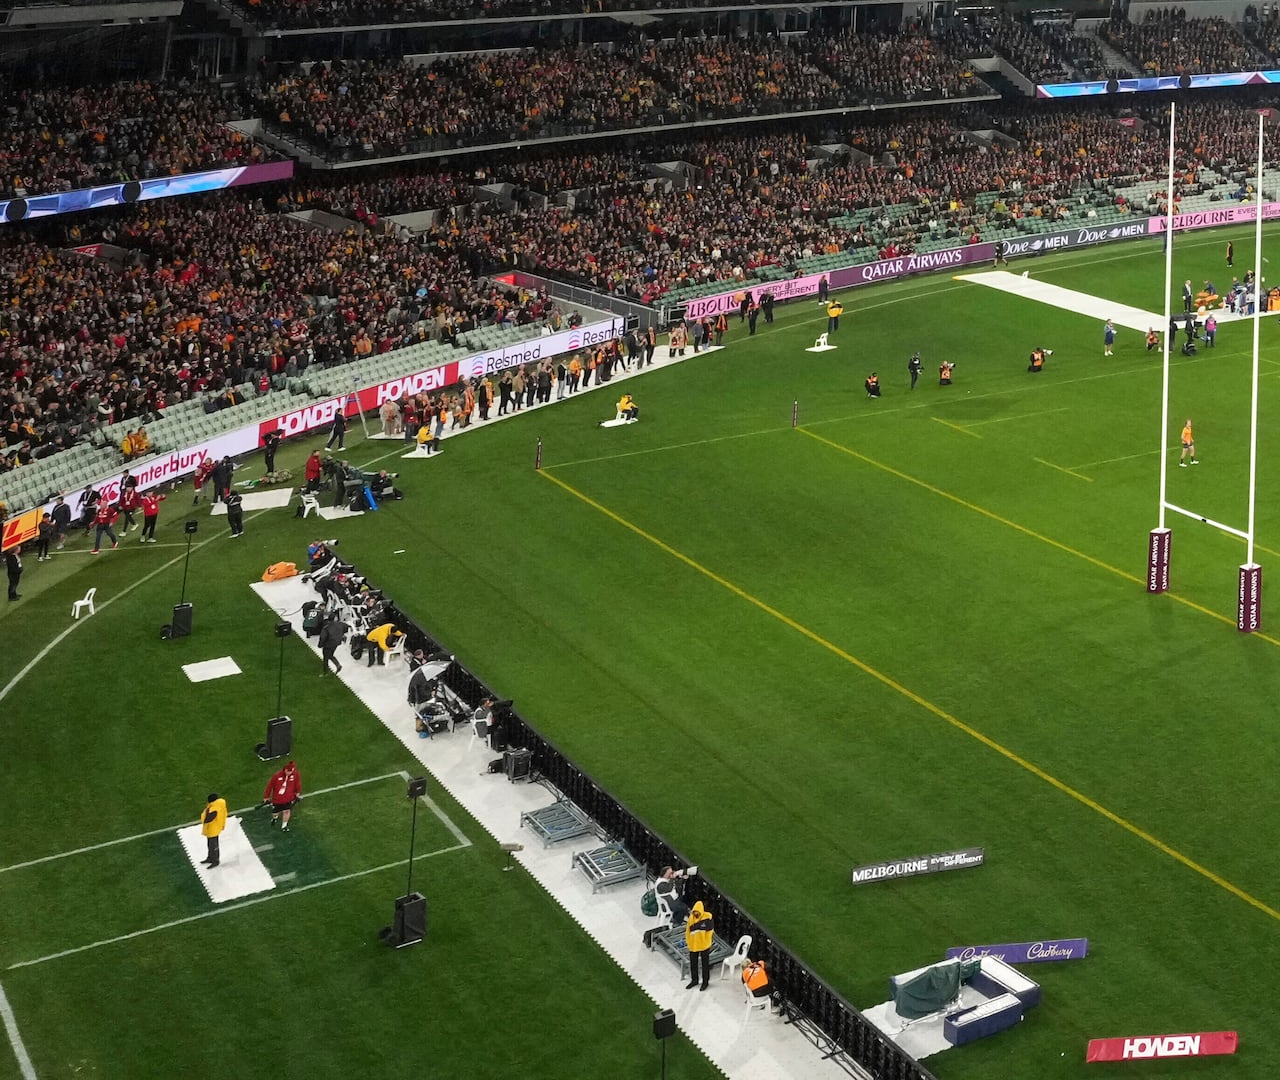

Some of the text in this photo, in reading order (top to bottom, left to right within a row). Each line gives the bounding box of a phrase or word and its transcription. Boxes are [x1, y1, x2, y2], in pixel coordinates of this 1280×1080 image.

[1077, 224, 1144, 243] Dove MEN
[1002, 236, 1068, 255] Dove MEN
[862, 249, 962, 280] QATAR AIRWAYS
[757, 283, 787, 296] EVERY
[583, 324, 625, 346] Resme
[486, 344, 542, 372] Resmed
[376, 365, 447, 406] HOWDEN
[277, 397, 349, 439] HOWDEN
[135, 448, 208, 487] anterbury
[1150, 535, 1160, 591] QATAR AIRWAYS
[1249, 571, 1258, 630] QATAR AIRWAYS
[852, 860, 928, 882] MELBOURNE
[930, 854, 954, 865] EVERY
[943, 855, 983, 867] DIFFERENT
[1026, 942, 1073, 960] Cadbury
[1122, 1035, 1201, 1059] HOWDEN
